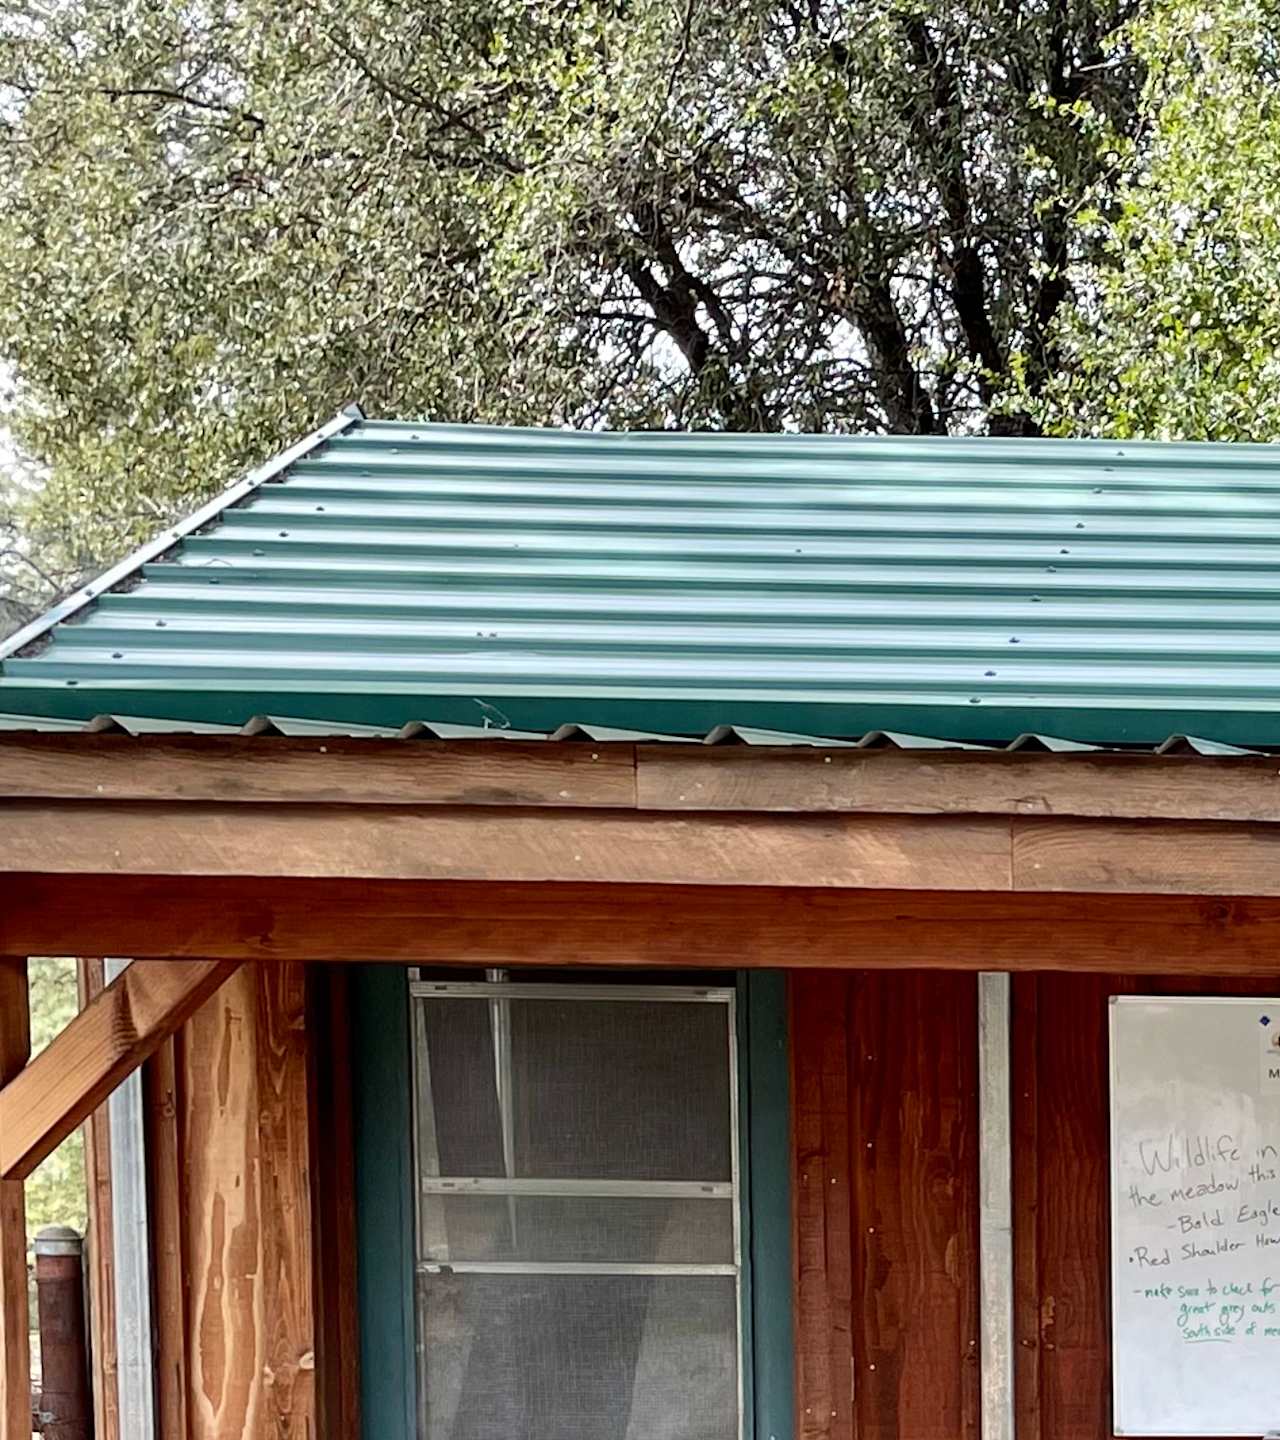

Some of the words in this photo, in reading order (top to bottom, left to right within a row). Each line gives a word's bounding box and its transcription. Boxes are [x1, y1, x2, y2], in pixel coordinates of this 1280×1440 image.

[1139, 1134, 1241, 1176] Wildlife
[1257, 1144, 1278, 1160] in
[1129, 1184, 1162, 1207] the
[1170, 1173, 1240, 1202] meadow
[1249, 1164, 1276, 1182] this
[1181, 1238, 1246, 1261] Shoulder
